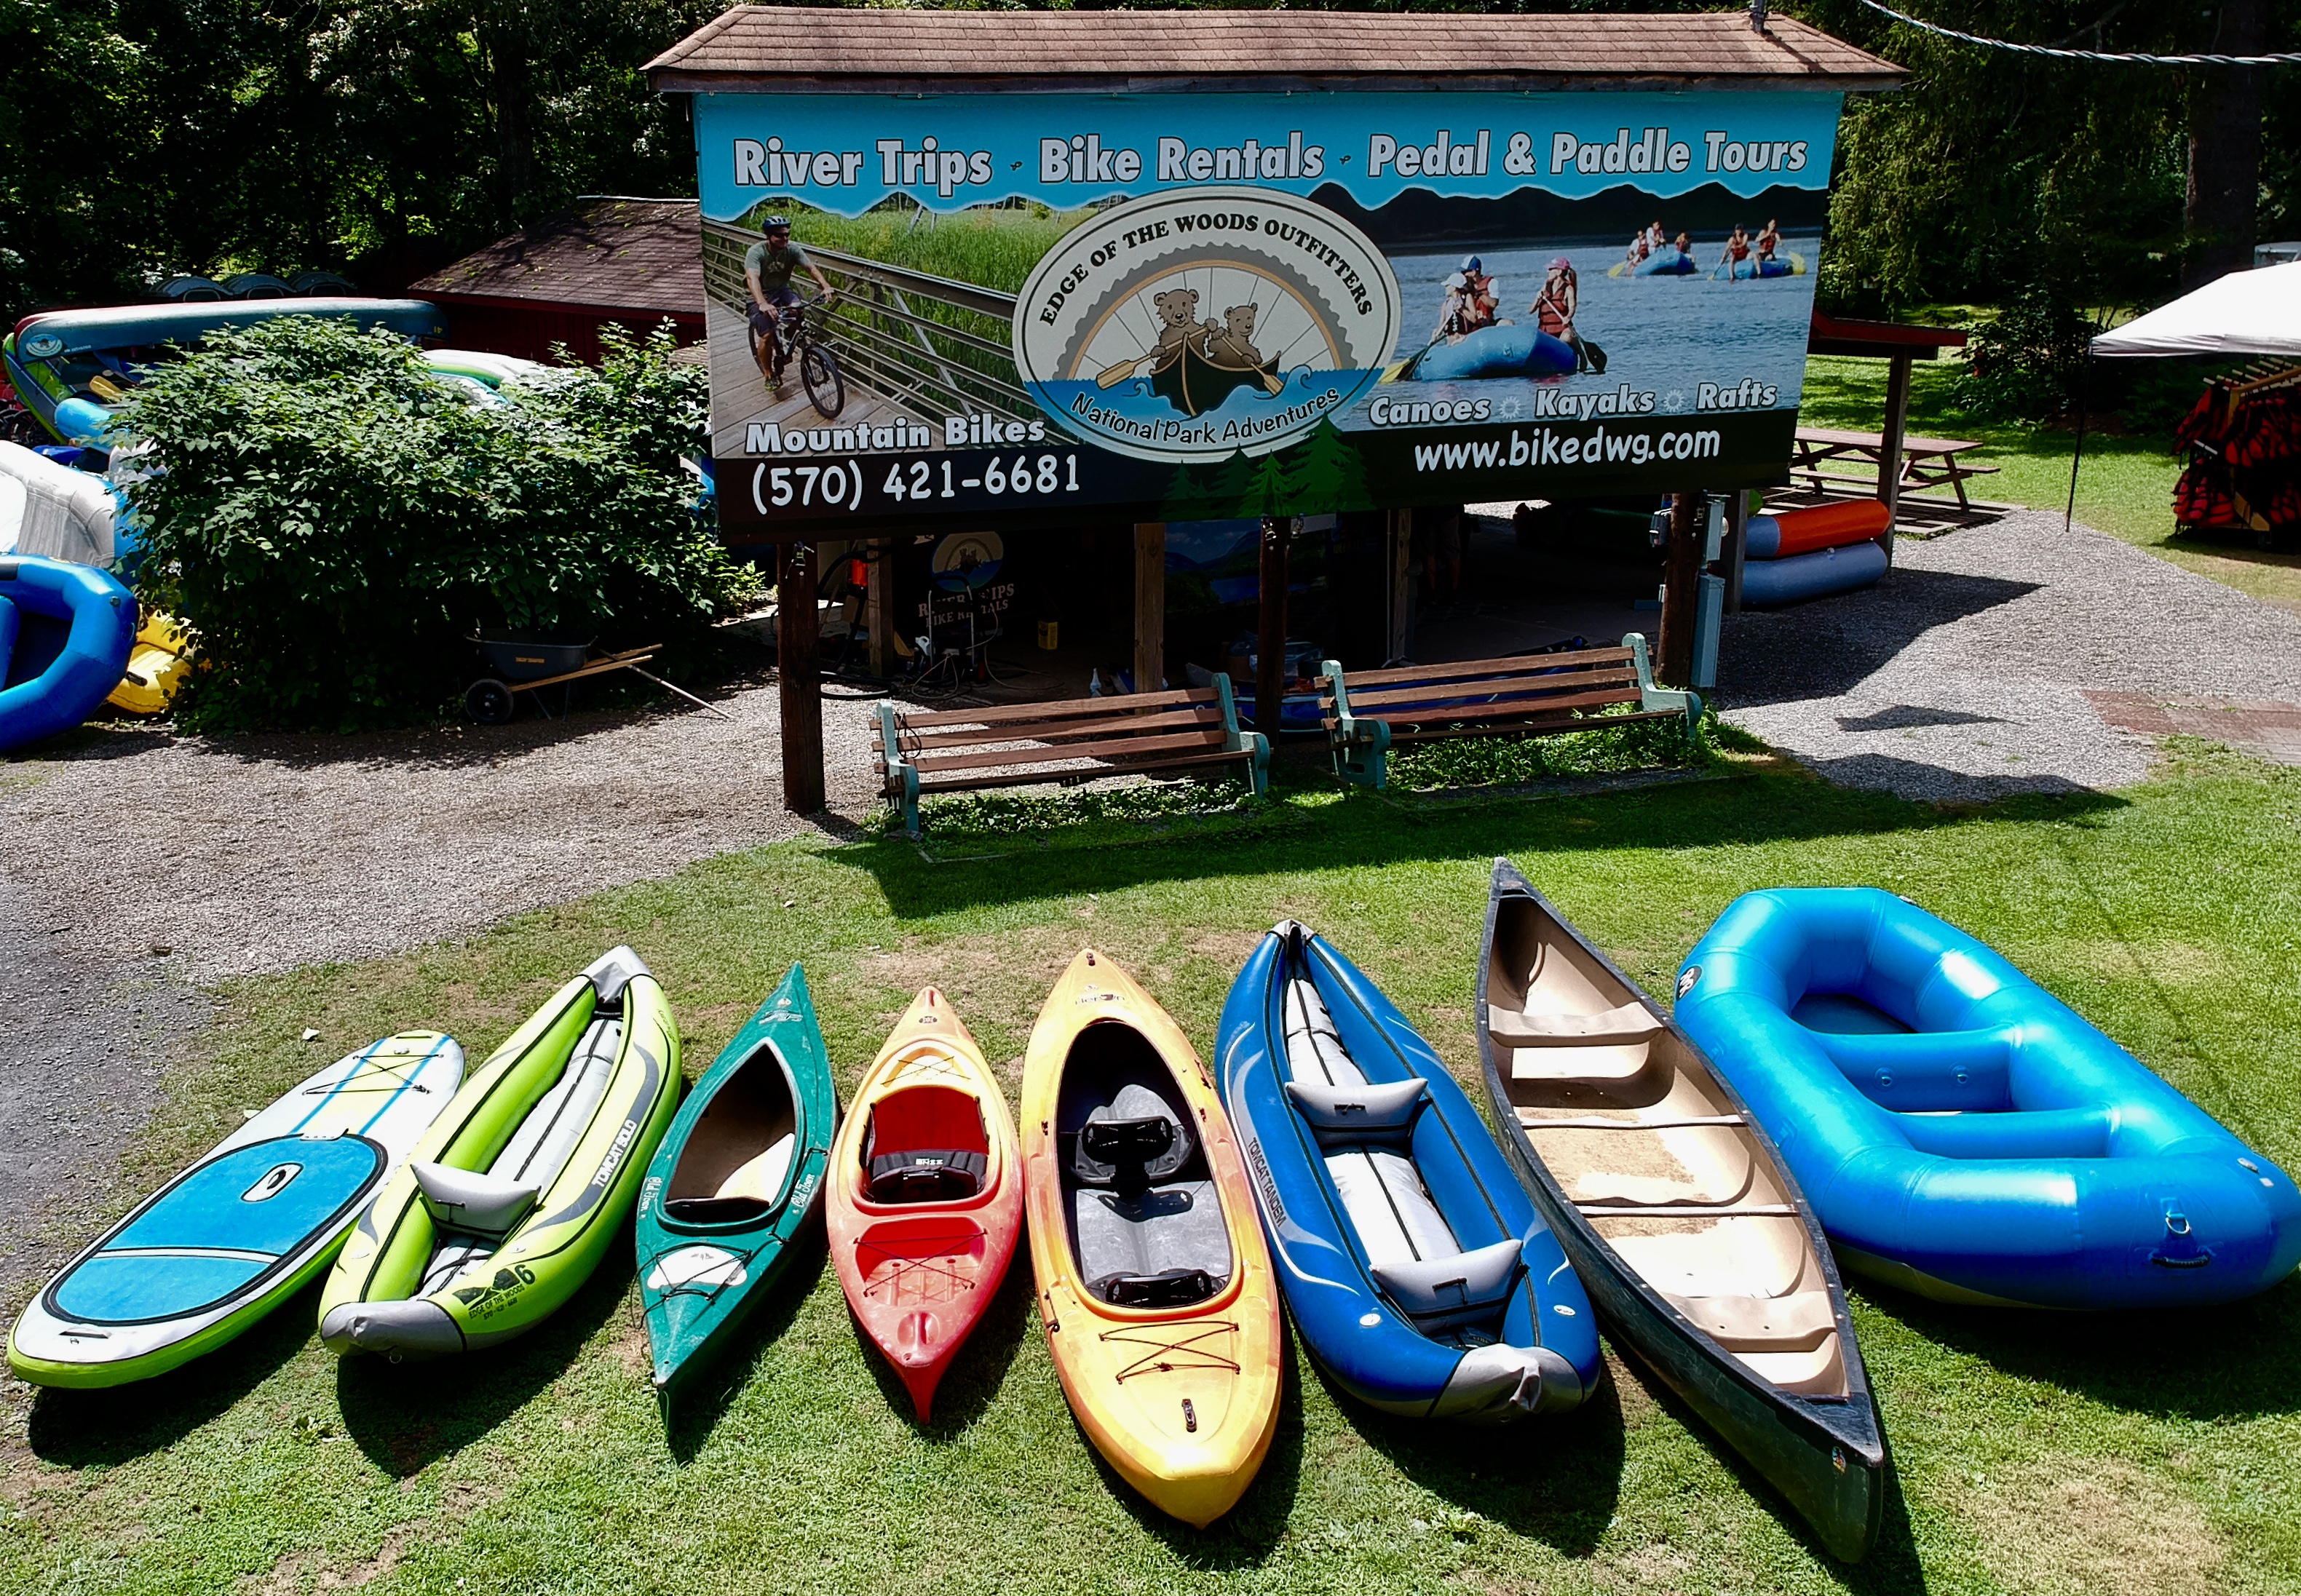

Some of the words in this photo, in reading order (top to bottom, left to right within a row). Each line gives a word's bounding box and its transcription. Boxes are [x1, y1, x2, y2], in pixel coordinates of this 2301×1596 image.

[734, 135, 863, 186] River
[876, 135, 992, 198] Trips
[1040, 134, 1141, 183] Bike
[1157, 132, 1325, 180] Rentals
[1368, 129, 1490, 178] Pedal
[1503, 130, 1536, 176] &
[1550, 127, 1690, 175] Paddle
[1703, 130, 1808, 172] Tours
[1040, 264, 1089, 326] EDGE
[1090, 241, 1117, 266] OF
[1122, 220, 1169, 249] THE
[1174, 213, 1259, 233] WOODS
[1264, 219, 1373, 316] OUTFITTERS
[1072, 392, 1160, 441] National
[1164, 422, 1216, 444] Park
[1222, 388, 1339, 441] Adventures
[1369, 397, 1490, 426] Canoes
[1536, 384, 1655, 421] Kayaks
[1697, 378, 1777, 409] Rafts
[745, 416, 930, 453] Mountain
[945, 413, 1045, 445] Bikes
[1415, 426, 1720, 472] www.bikedwg.com
[753, 460, 862, 515] (570)
[883, 454, 1079, 501] 421-6681
[592, 1143, 624, 1187] TOMCAT
[615, 1119, 637, 1147] SOLO
[1248, 1137, 1270, 1180] TOMCAT
[1263, 1177, 1287, 1227] TANDEM
[514, 1264, 536, 1285] 6
[469, 1305, 486, 1319] EDGE
[485, 1300, 494, 1309] OF
[494, 1294, 504, 1305] THE
[504, 1284, 526, 1300] WOODS
